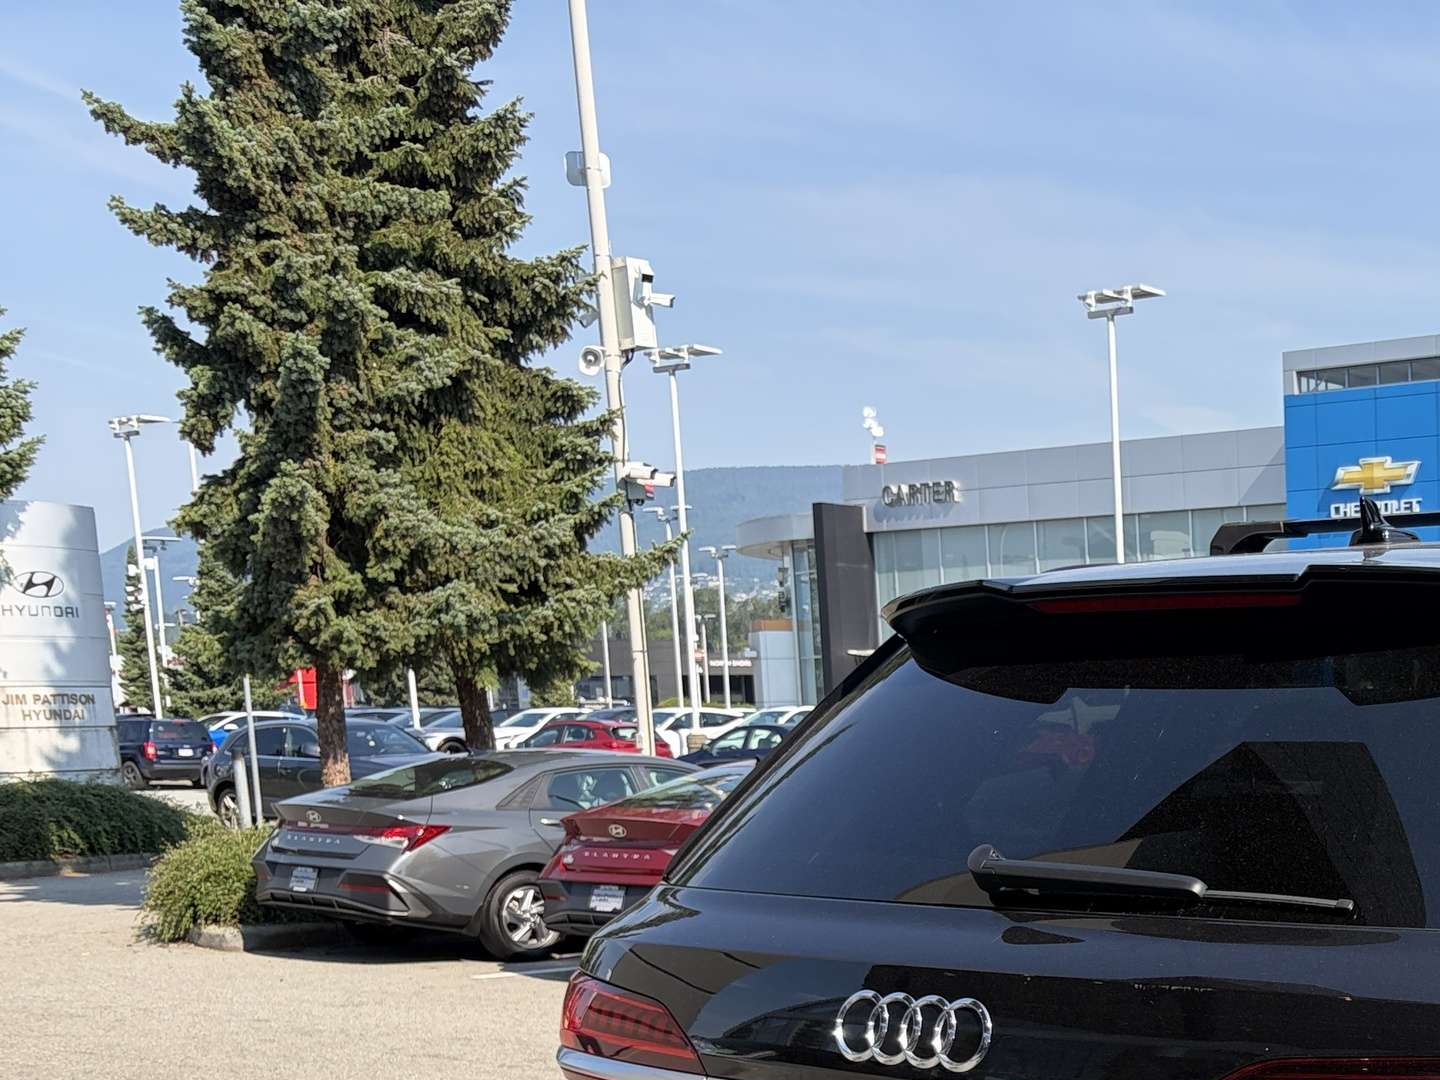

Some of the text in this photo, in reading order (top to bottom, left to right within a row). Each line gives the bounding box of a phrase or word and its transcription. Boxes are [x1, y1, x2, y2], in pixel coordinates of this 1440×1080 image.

[882, 481, 960, 508] CARTER
[1330, 498, 1423, 518] CHEOLET
[1, 605, 80, 618] HYUNDAI
[2, 693, 96, 705] JIM PATTISON
[22, 709, 85, 721] HYUNDAI
